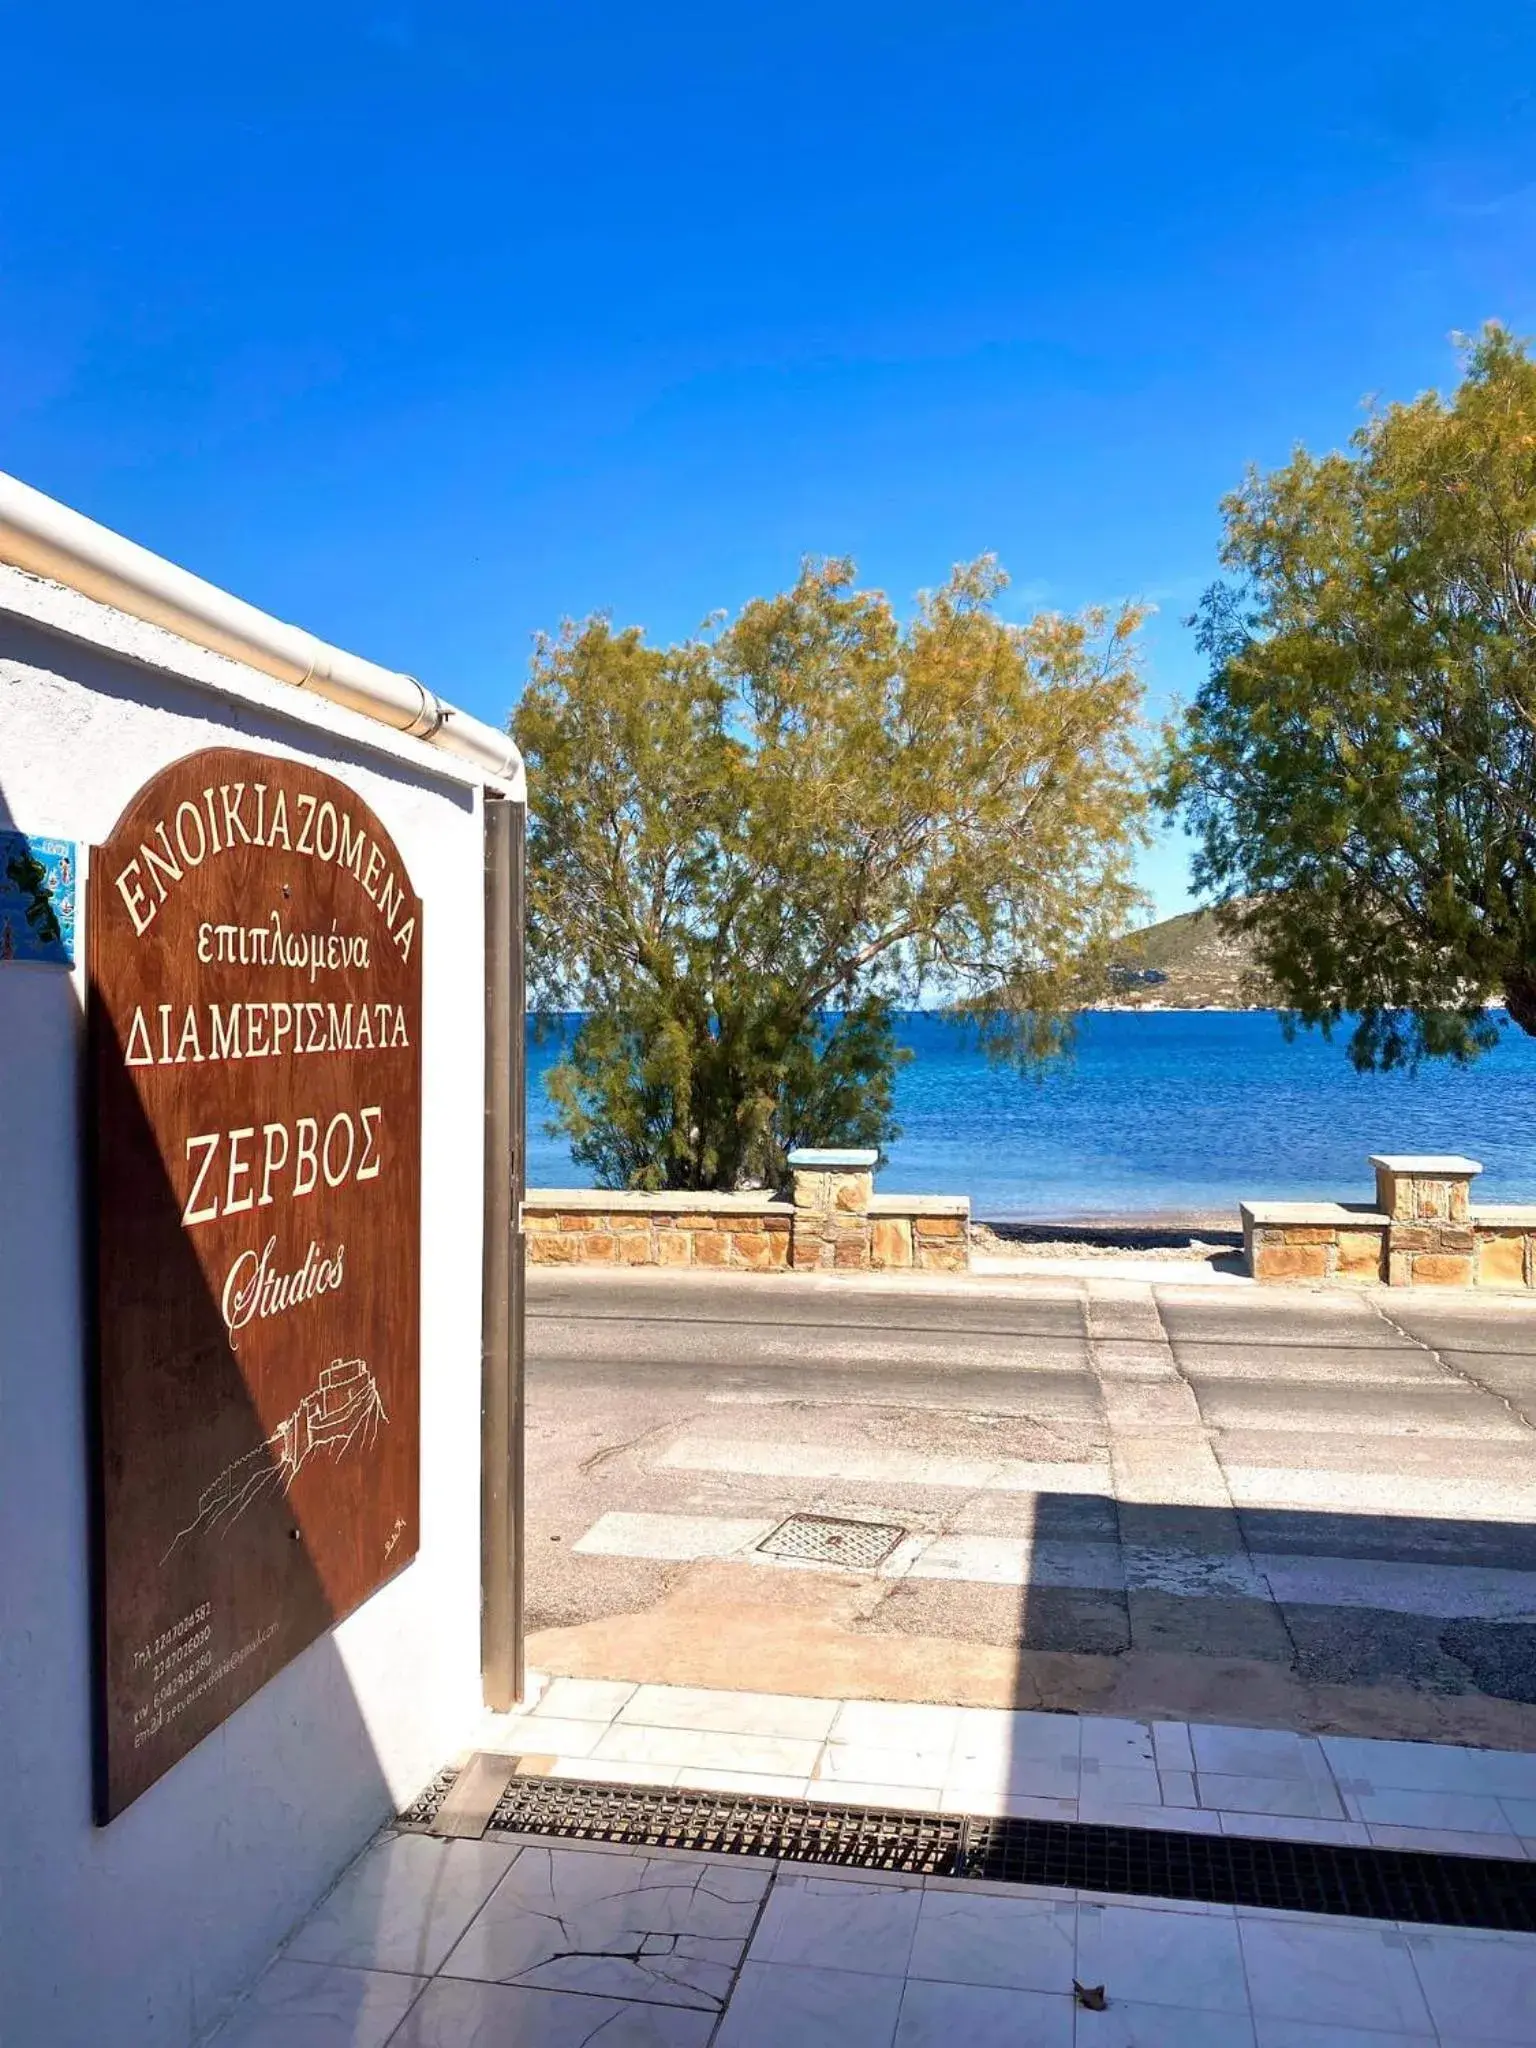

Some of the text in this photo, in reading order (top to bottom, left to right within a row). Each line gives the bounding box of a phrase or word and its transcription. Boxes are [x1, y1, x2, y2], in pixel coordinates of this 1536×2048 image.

[115, 782, 416, 965] ΕΝΟΙΚΙΑΖΟΜΕΝΑ
[197, 910, 371, 983] επιπλωμένα
[123, 1002, 410, 1067] ΔΙΑΜΕΡΙΣΜΑΤΑ
[180, 1105, 382, 1228] ΖΕΡΒΟΣ
[221, 1234, 345, 1351] Studios
